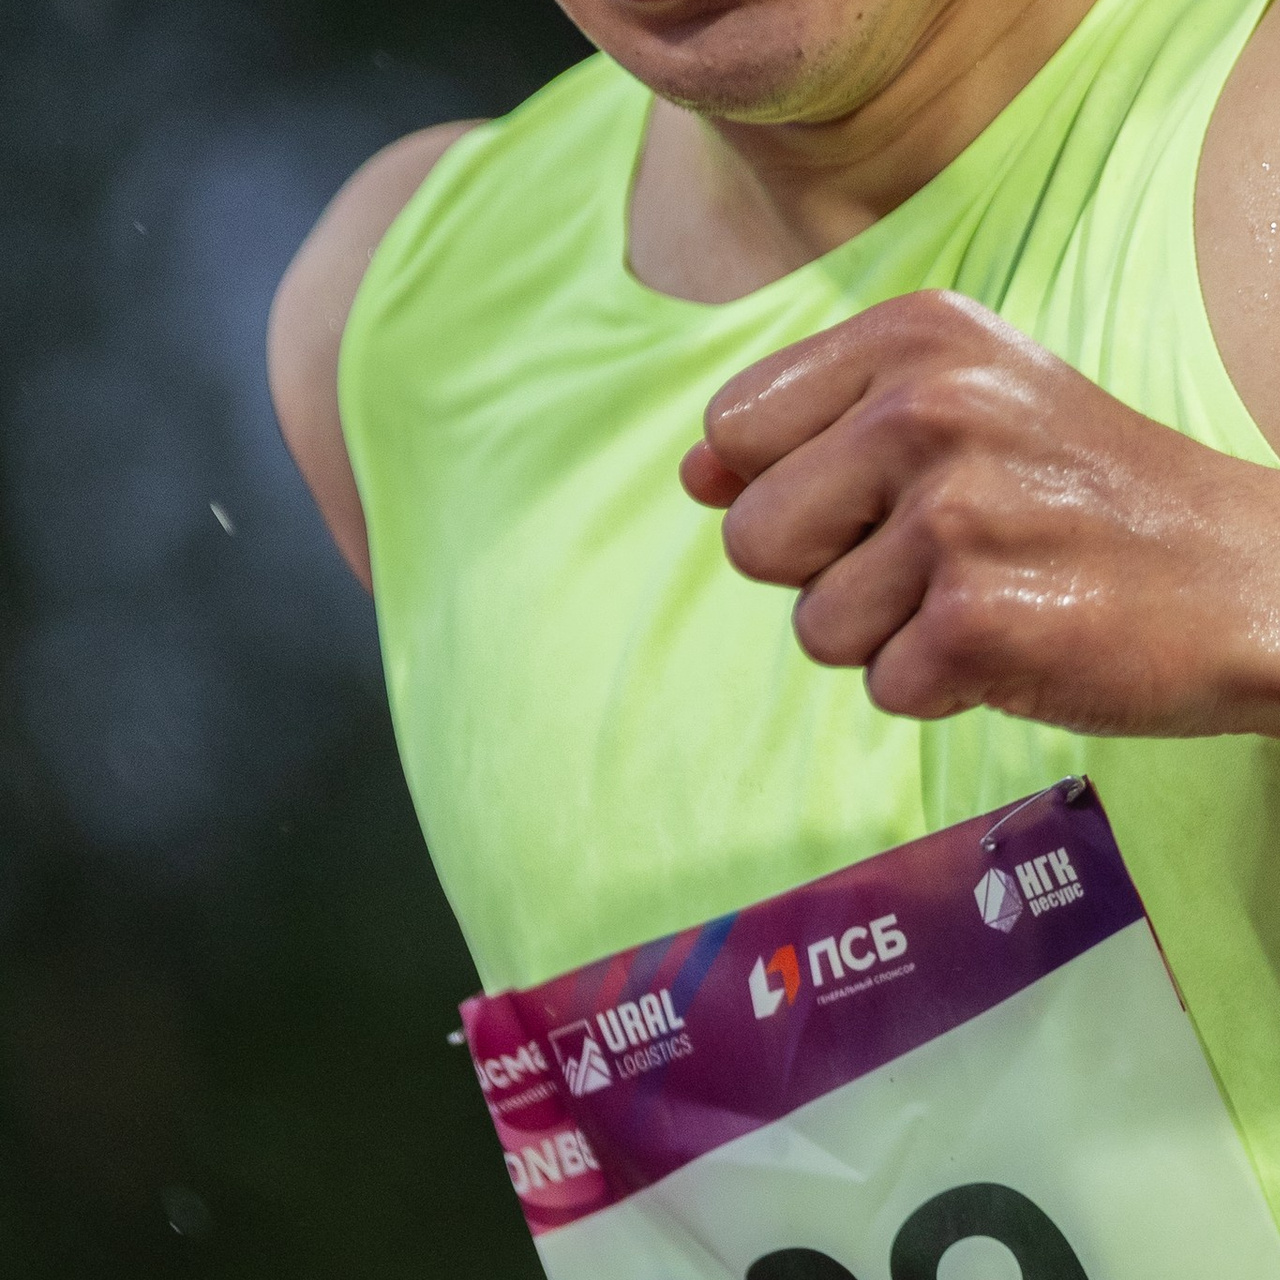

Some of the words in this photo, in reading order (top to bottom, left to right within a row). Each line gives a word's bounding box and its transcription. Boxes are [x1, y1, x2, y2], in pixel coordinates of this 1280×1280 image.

[1014, 847, 1079, 900] НГК
[1028, 881, 1085, 918] ресурс
[807, 912, 909, 988] ПСБ
[596, 988, 686, 1053] URAL
[614, 1032, 695, 1080] LOGISTICS
